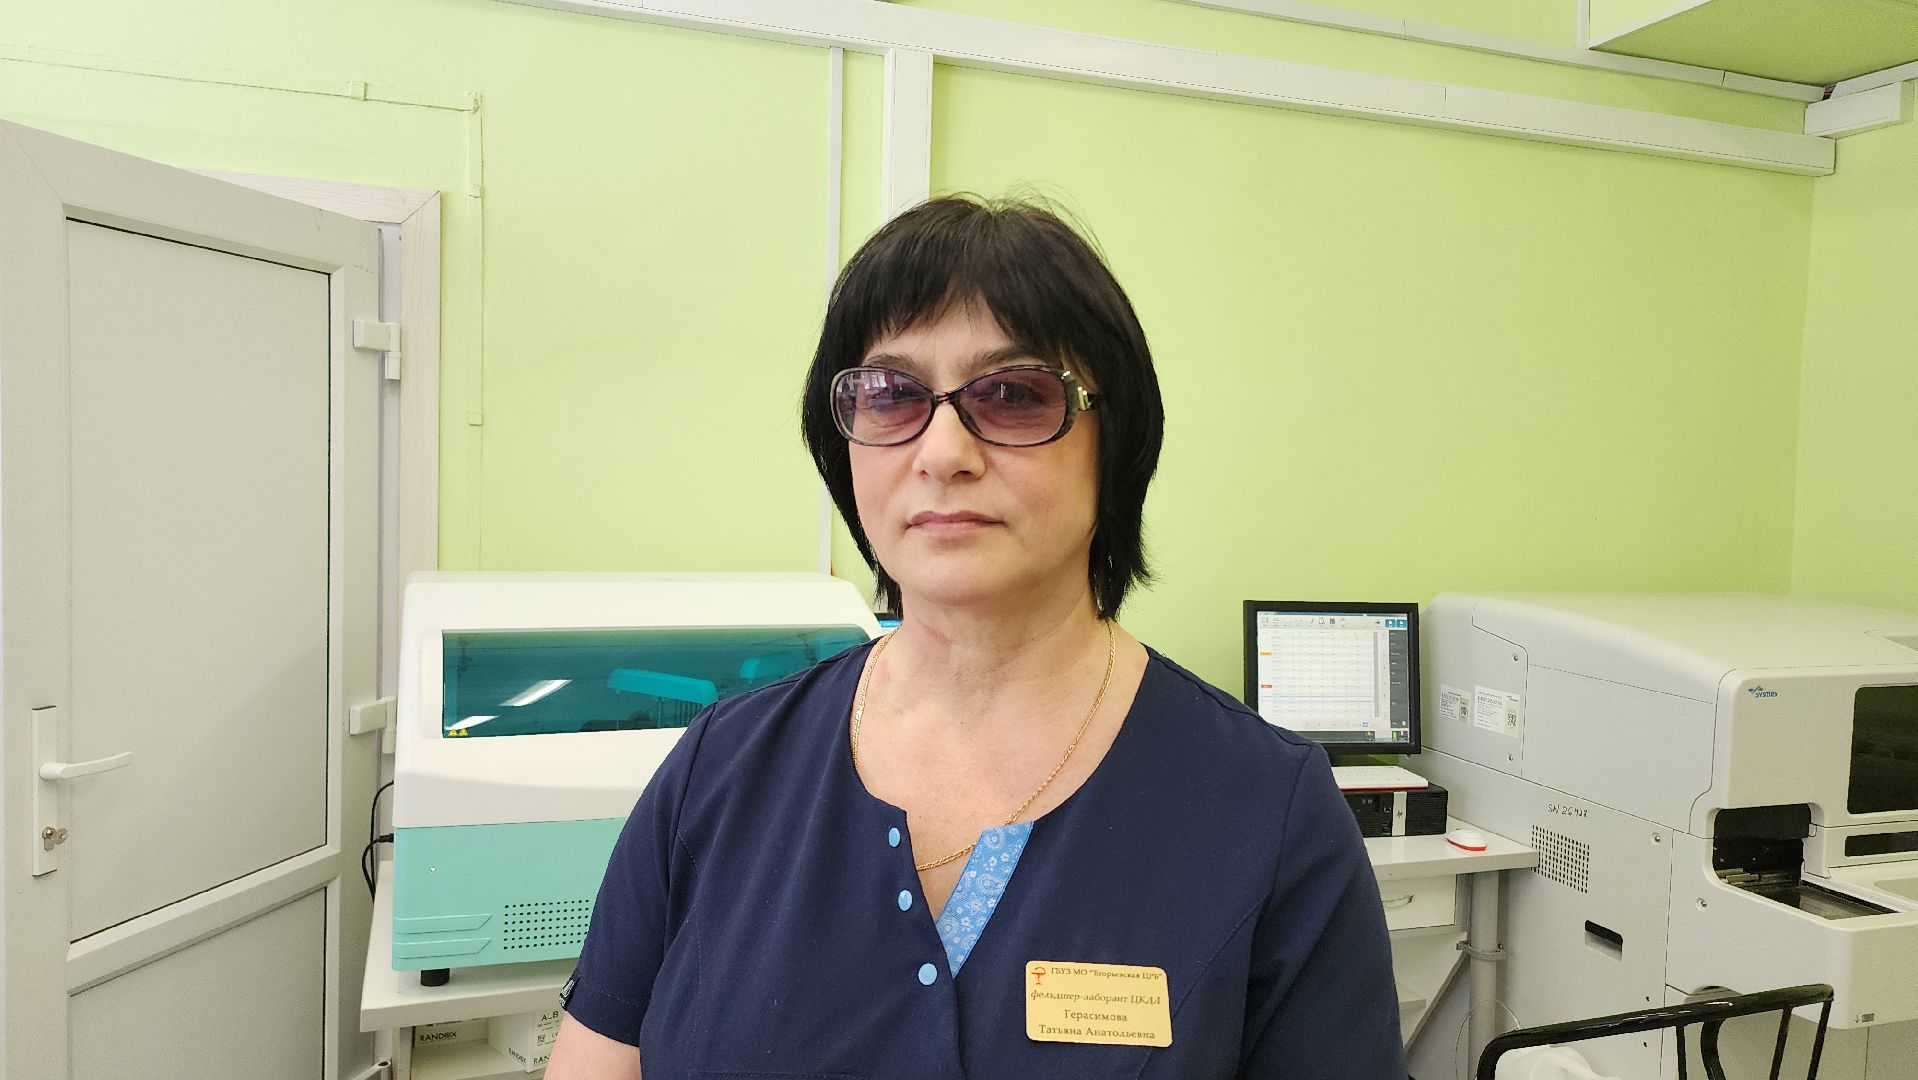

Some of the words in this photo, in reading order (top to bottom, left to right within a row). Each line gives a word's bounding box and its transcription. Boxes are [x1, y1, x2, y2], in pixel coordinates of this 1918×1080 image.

[1051, 967, 1071, 975] ГБУЗ
[1030, 989, 1128, 1004] фельдшер-лаборант
[1064, 1009, 1127, 1021] Герасимова
[420, 1031, 457, 1042] RANDOX
[1039, 1024, 1082, 1036] Татьяна
[1085, 1027, 1155, 1039] Анатольевна
